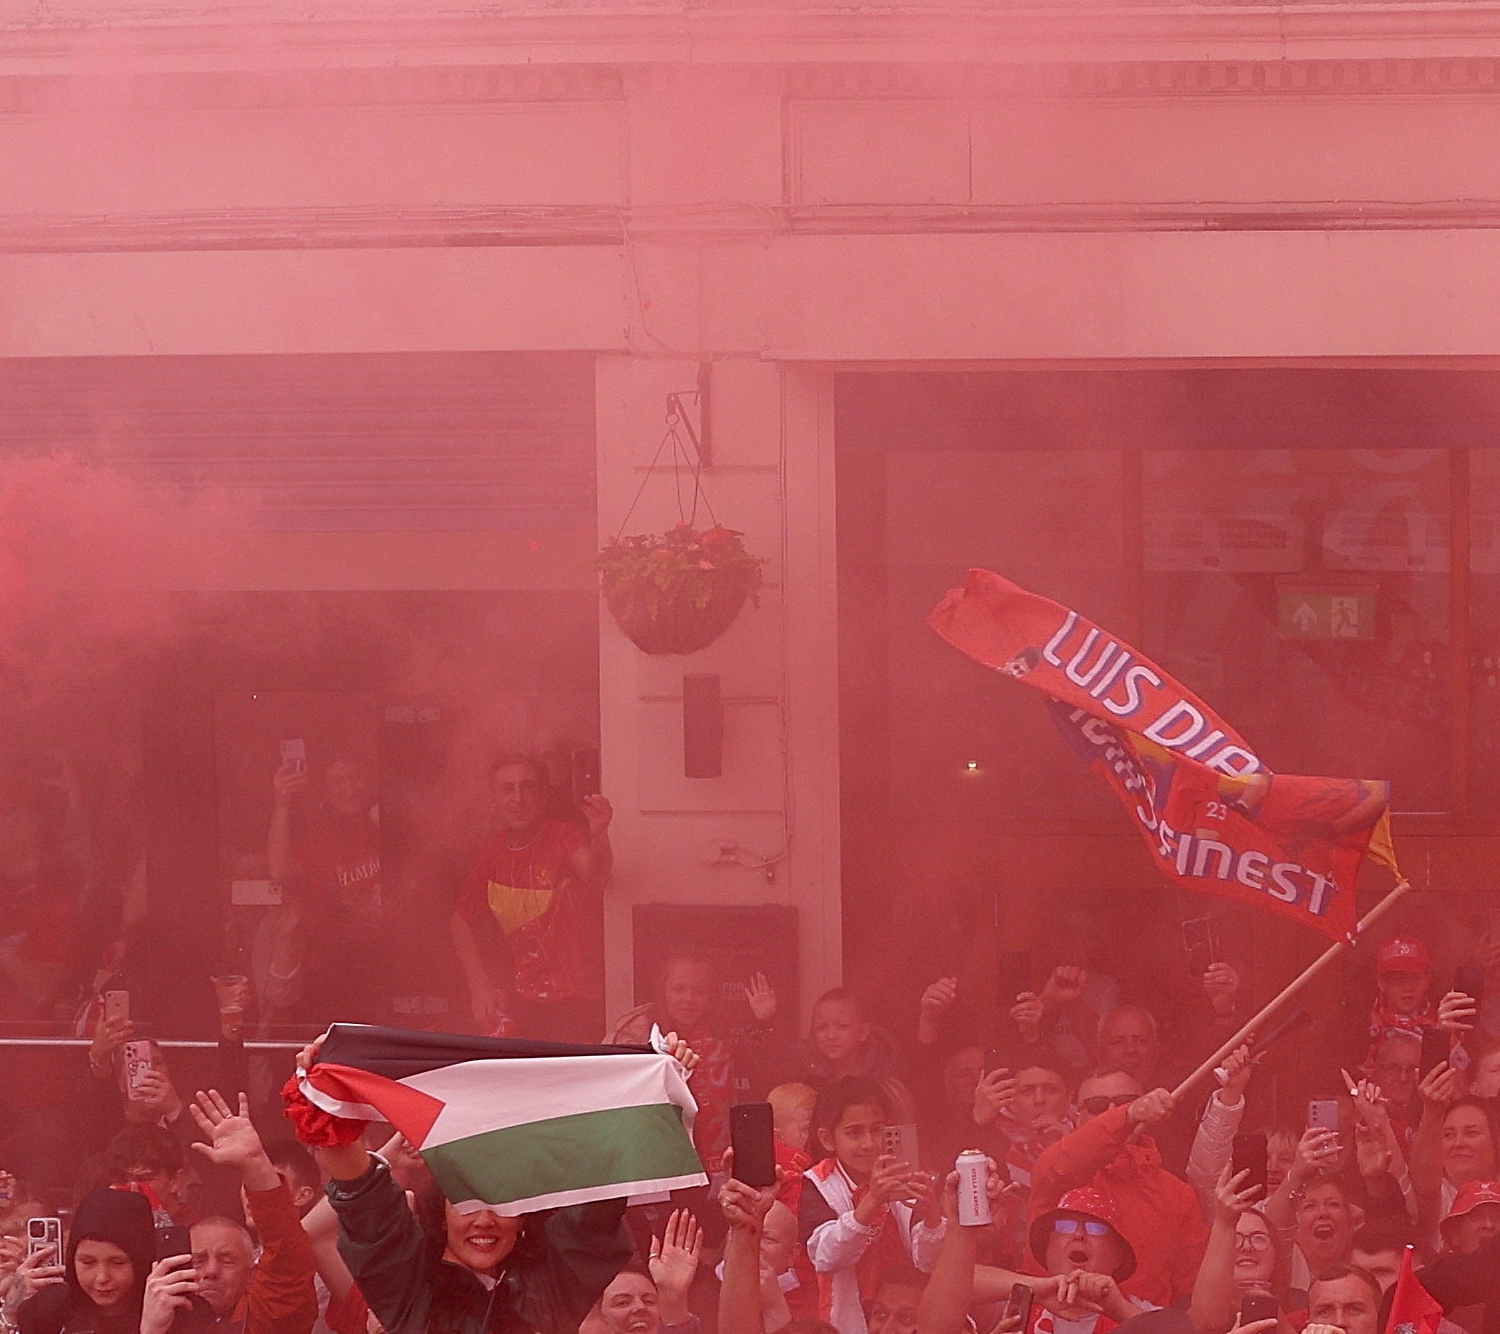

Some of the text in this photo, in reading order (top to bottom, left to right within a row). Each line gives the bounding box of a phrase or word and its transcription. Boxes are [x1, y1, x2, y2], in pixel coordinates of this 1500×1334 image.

[1041, 610, 1162, 717] LUIS
[1142, 698, 1262, 779] DIA
[1206, 801, 1228, 821] 23
